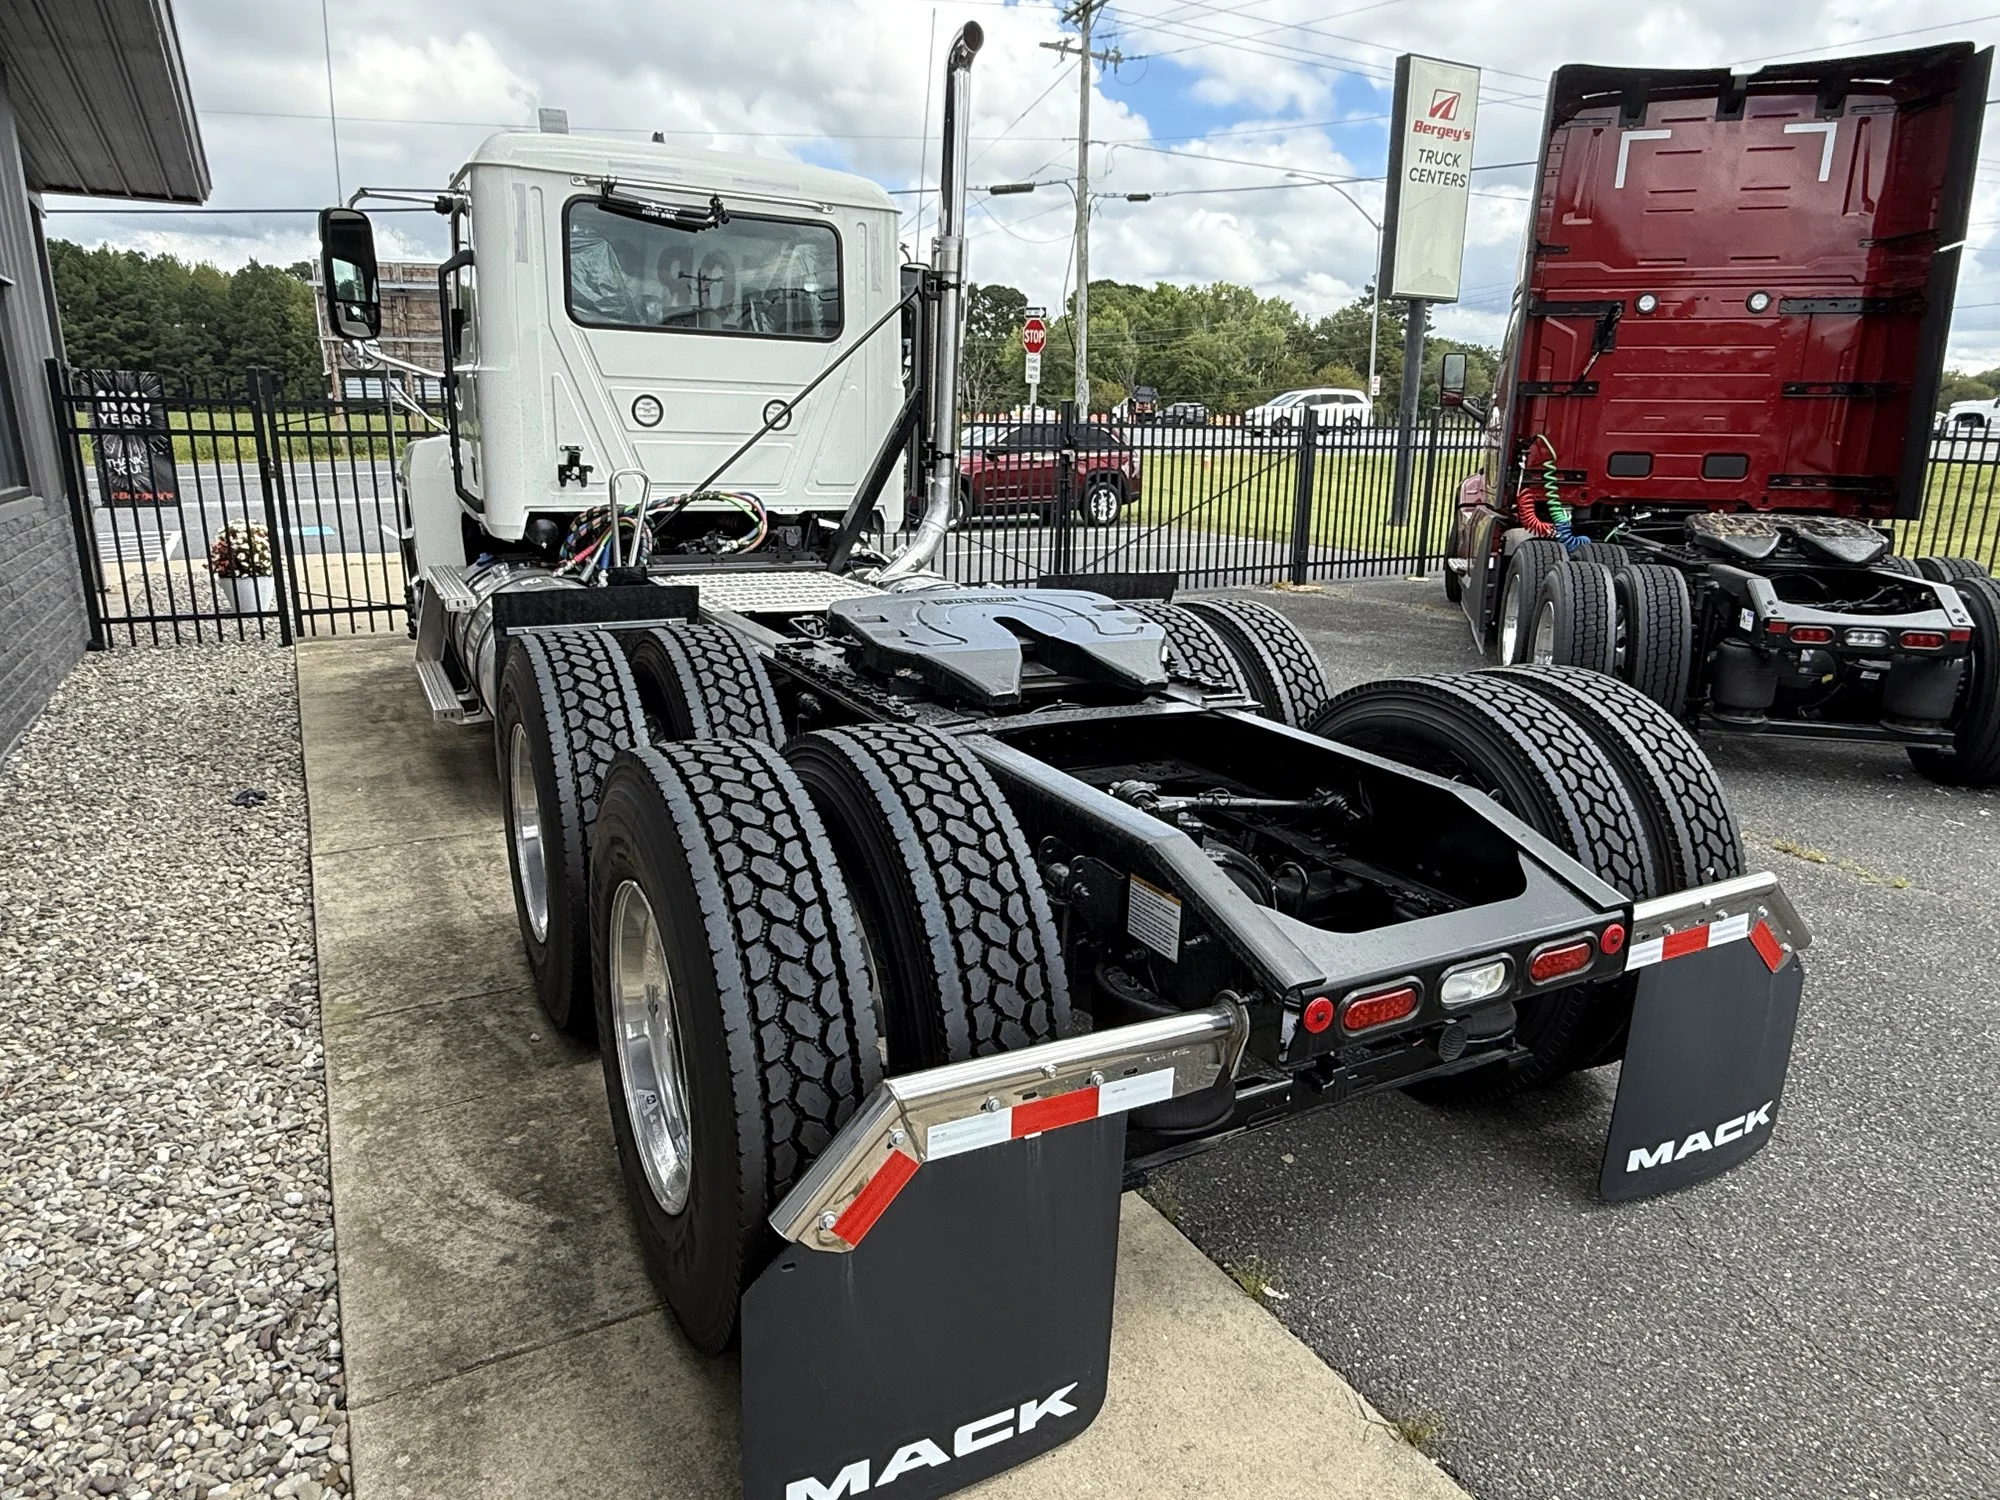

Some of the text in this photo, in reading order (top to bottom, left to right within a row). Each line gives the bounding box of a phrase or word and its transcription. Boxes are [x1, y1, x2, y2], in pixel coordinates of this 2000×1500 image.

[1413, 120, 1471, 142] Bergey's
[1419, 149, 1462, 168] TRUCK
[1409, 167, 1467, 188] CENTERS
[1024, 329, 1044, 344] STOP
[98, 413, 151, 425] YEARS
[1626, 1100, 1774, 1173] MACK
[786, 1381, 1078, 1500] MACK
